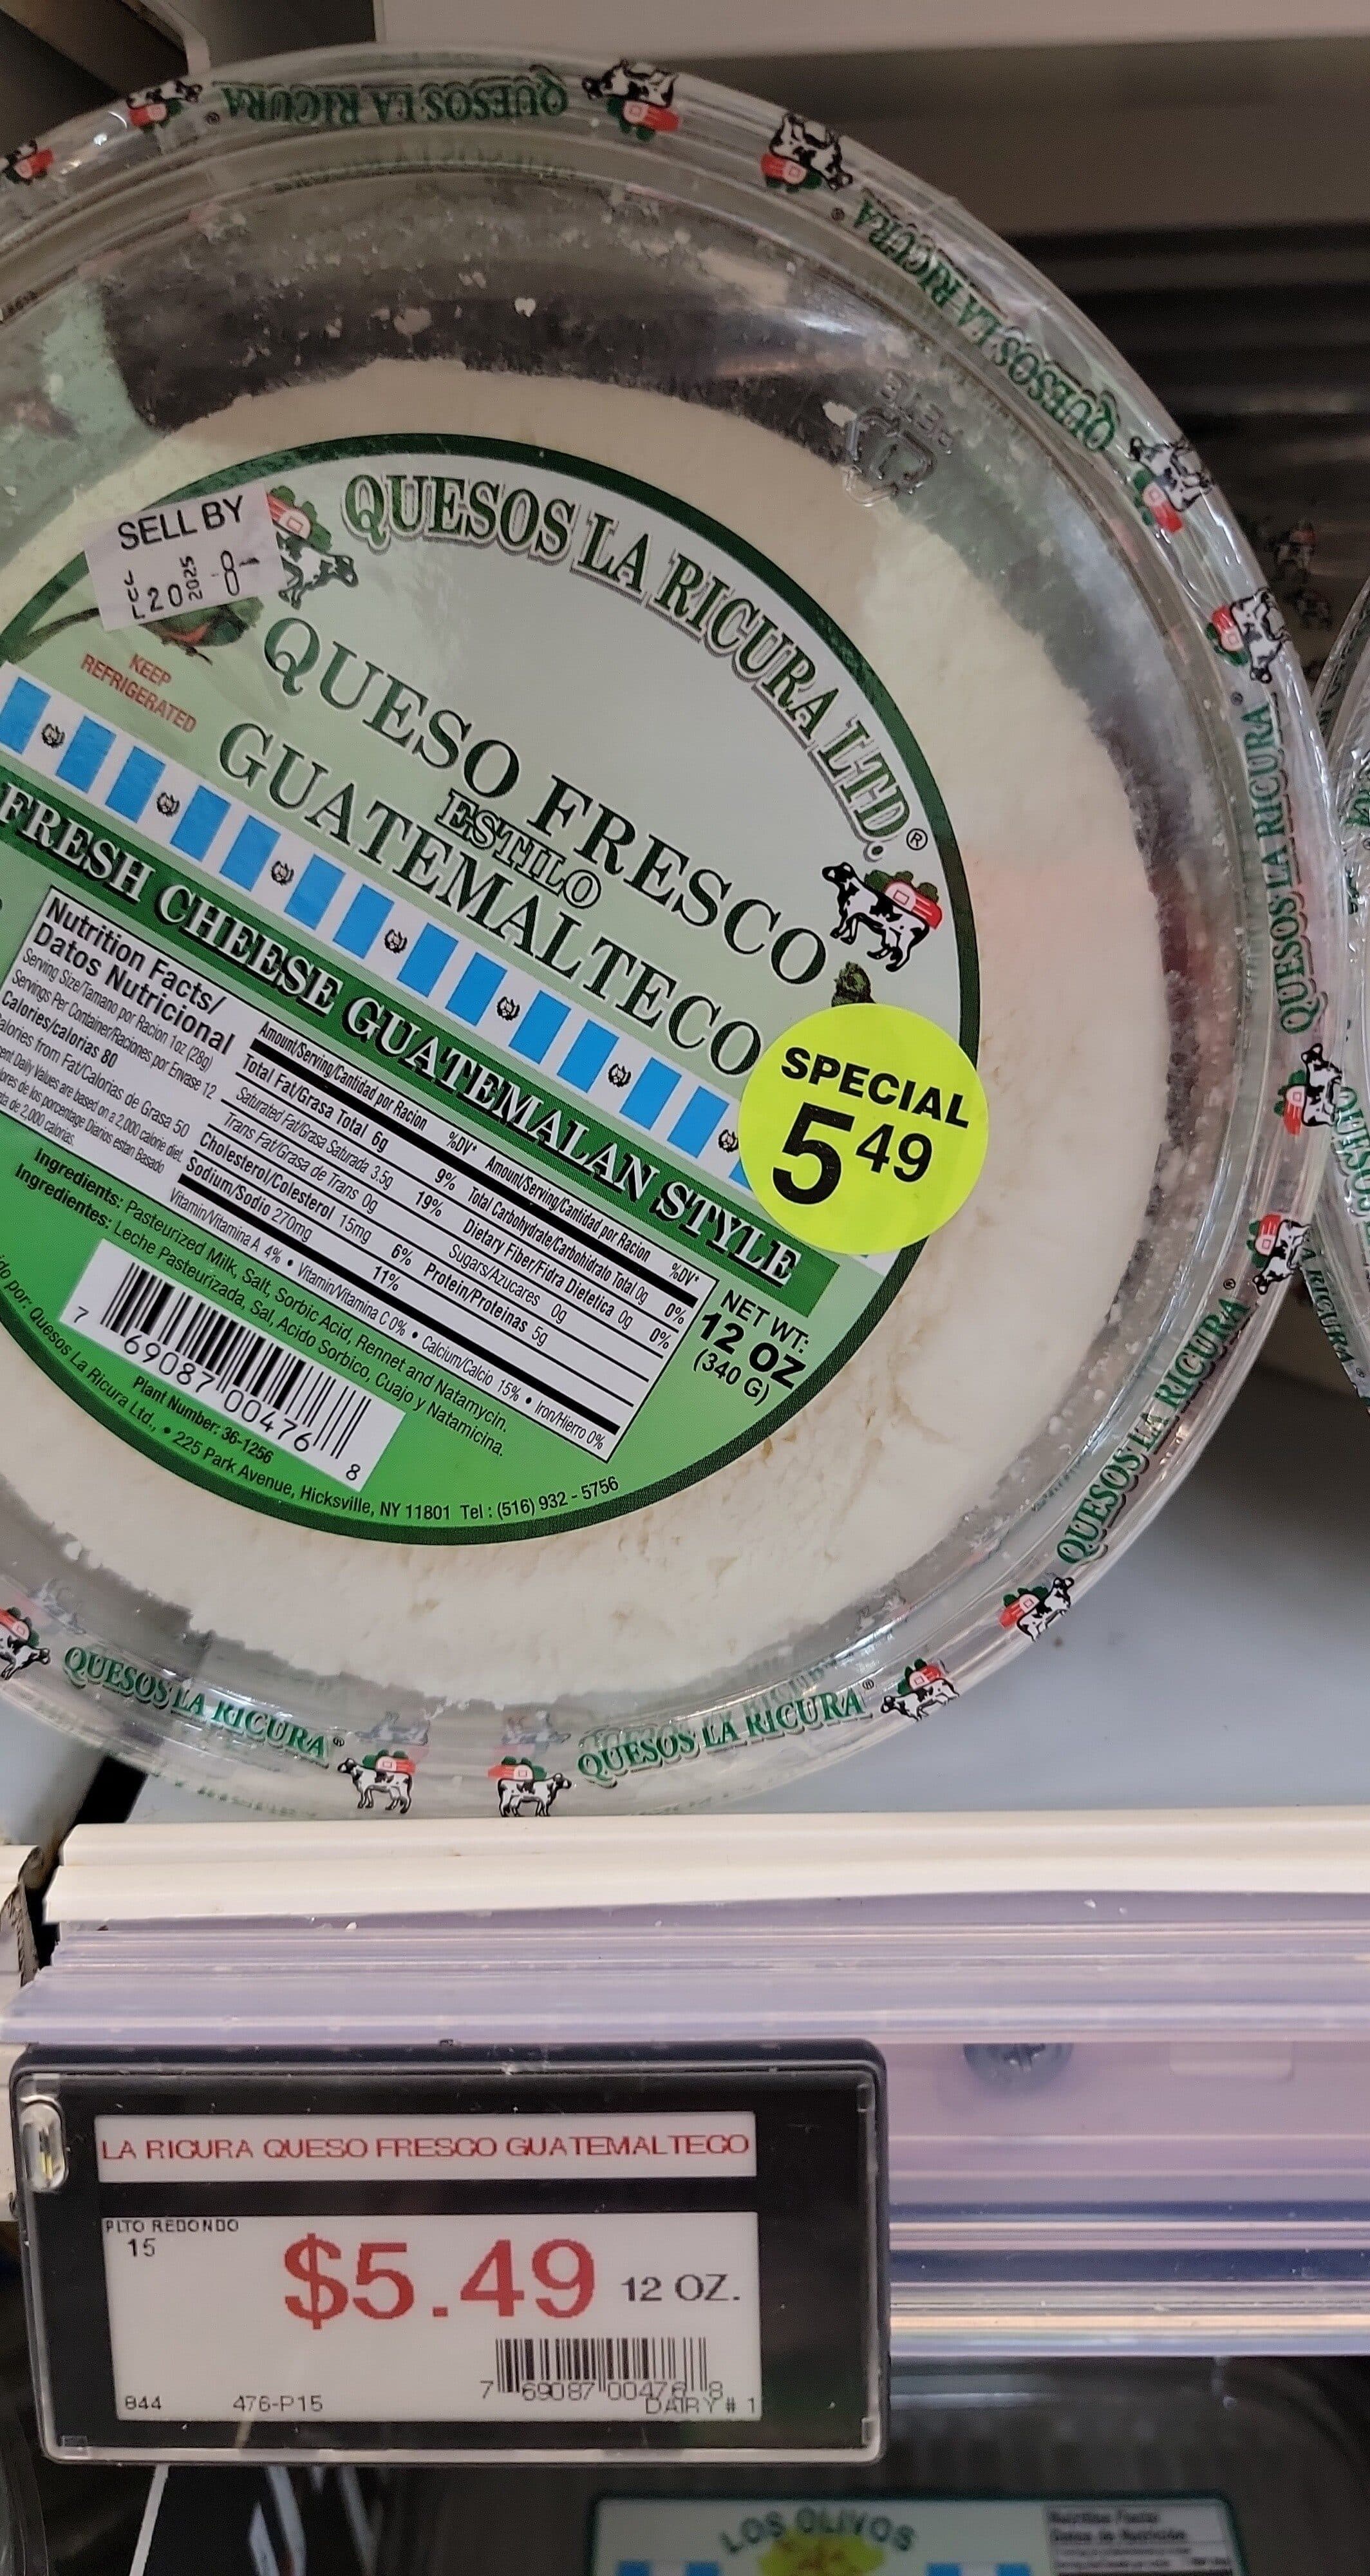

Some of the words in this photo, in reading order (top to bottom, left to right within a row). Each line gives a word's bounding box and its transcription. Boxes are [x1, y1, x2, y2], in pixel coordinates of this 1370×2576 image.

[216, 82, 360, 126] RICURA
[362, 82, 420, 123] LA
[419, 73, 570, 123] QUESOS
[957, 294, 1002, 346] LA
[988, 337, 1116, 451] QUESOS
[117, 507, 198, 551] SELL
[202, 495, 244, 529] BY
[80, 653, 198, 734] REFRIGERATED
[128, 653, 173, 687] KEEP
[342, 472, 577, 557] QUESOS
[574, 514, 653, 598] LA
[650, 551, 841, 744] RICURA
[814, 717, 912, 862] LTD.
[262, 614, 521, 800] QUESO
[529, 773, 829, 987] FRESCO
[1241, 703, 1286, 839] RICURA
[434, 787, 604, 909] ESTILO
[1261, 844, 1293, 891] LA
[218, 721, 764, 1079] GUATEMALTECO
[32, 921, 102, 976] Datos
[104, 963, 236, 1055] Nutricional
[44, 896, 146, 972] Nutrition
[147, 957, 227, 1015] Facts/
[1268, 898, 1322, 1034] QUESOS
[0, 781, 156, 904] FRESH
[156, 882, 344, 1017] CHEESE
[342, 996, 660, 1203] GUATEMALAN
[652, 1179, 804, 1288] STYLE
[1, 989, 100, 1058] Calories/calorias
[100, 1048, 118, 1068] 80
[21, 947, 60, 983] Serving
[58, 968, 118, 1014] Size/Tamano
[115, 1006, 137, 1025] por
[134, 1013, 169, 1045] Racion
[185, 1045, 214, 1073] (28g)
[242, 1052, 276, 1083] Total
[273, 1072, 334, 1119] Fat/Grasa
[335, 1108, 369, 1139] Total
[370, 1130, 389, 1153] 6g
[434, 1168, 457, 1191] 9%
[258, 1020, 379, 1101] Amount/Serving/Cantidad
[372, 1092, 395, 1110] por
[391, 1099, 427, 1131] Racion
[780, 1046, 970, 1130] SPECIAL
[199, 1131, 336, 1220] Cholesterol/Colesterol
[339, 1213, 372, 1245] 15mg
[390, 1243, 413, 1266] 6%
[772, 1101, 856, 1206] 5
[854, 1122, 933, 1183] 49
[185, 1155, 271, 1216] Sodium/Sodio
[270, 1207, 313, 1243] 270mg
[372, 1265, 401, 1291] 11%
[14, 1162, 113, 1229] Ingredientes:
[113, 1218, 156, 1255] Leche
[156, 1245, 245, 1311] Pasteurizada,
[249, 1299, 276, 1327] Sal,
[275, 1315, 317, 1347] Acido
[317, 1338, 370, 1383] Sorbico,
[375, 1372, 414, 1403] Cuajo
[411, 1396, 427, 1412] y
[425, 1400, 503, 1457] Natamicina.
[33, 1146, 124, 1209] Ingredients:
[124, 1198, 208, 1256] Pasteurized
[205, 1246, 238, 1280] Milk,
[241, 1267, 272, 1298] Salt,
[274, 1287, 319, 1322] Sorbic
[317, 1313, 353, 1345] Acid,
[354, 1332, 406, 1372] Rennet
[404, 1365, 435, 1388] and
[433, 1378, 506, 1433] Natamycin.
[169, 1186, 252, 1247] Vitamin/Vitamina
[249, 1236, 261, 1252] A
[263, 1244, 283, 1264] 4%
[297, 1261, 379, 1321] Vitamin/Vitamina
[378, 1310, 390, 1325] C
[388, 1316, 408, 1336] 0%
[421, 1334, 494, 1386] Calcium/Calcio
[496, 1378, 521, 1402] 15%
[533, 1399, 586, 1439] Iron/Hierro
[585, 1430, 606, 1450] 0%
[422, 1261, 528, 1332] Protein/Proteinas
[530, 1325, 549, 1347] 5g
[447, 1243, 541, 1306] Sugars/Azucares
[550, 1303, 568, 1325] 0g
[462, 1217, 505, 1255] Dietary
[503, 1242, 565, 1288] Fiber/Fidra
[563, 1277, 615, 1317] Dietetica
[617, 1309, 633, 1331] 0g
[648, 1327, 671, 1349] 0%
[719, 1288, 771, 1327] NET
[769, 1315, 809, 1354] WT:
[73, 1305, 90, 1324] 7
[123, 1334, 216, 1394] 69087
[221, 1388, 312, 1453] 00476
[344, 1463, 362, 1482] 8
[693, 1347, 742, 1385] (340
[743, 1376, 769, 1407] G)
[699, 1311, 744, 1355] 12
[748, 1341, 806, 1390] OZ
[29, 1306, 73, 1357] Quesos
[70, 1350, 88, 1373] La
[87, 1367, 130, 1409] Ricura
[173, 1431, 204, 1456] 225
[202, 1450, 238, 1475] Park
[237, 1464, 296, 1500] Avenue,
[299, 1484, 375, 1518] Hicksville,
[380, 1501, 402, 1518] NY
[405, 1504, 451, 1521] 11801
[460, 1502, 484, 1521] Tel
[496, 1497, 536, 1520] (516)
[538, 1491, 568, 1511] 932
[581, 1475, 620, 1501] 5756
[132, 1376, 166, 1406] Plant
[166, 1393, 222, 1435] Number:
[220, 1426, 274, 1464] 36-1256
[1055, 1446, 1143, 1565] QUESOS
[1153, 1296, 1252, 1410] RICURA
[63, 1643, 171, 1709] QUESOS
[172, 1683, 207, 1718] LA
[212, 1699, 328, 1761] RICURA
[576, 1730, 699, 1783] QUESOS
[701, 1720, 738, 1750] LA
[745, 1690, 867, 1741] RICURA
[102, 2139, 137, 2159] LA
[262, 2137, 369, 2159] QUESO
[127, 2237, 156, 2257] 15
[153, 2219, 239, 2233] REDONDO
[283, 2231, 596, 2331] $5.49
[619, 2275, 664, 2303] 12
[673, 2272, 741, 2302] OZ.
[480, 2379, 494, 2400] 7
[644, 2397, 718, 2415] DAIRY
[747, 2396, 756, 2414] 1
[718, 2511, 787, 2556] LOS
[796, 2506, 917, 2552] OLIVOS
